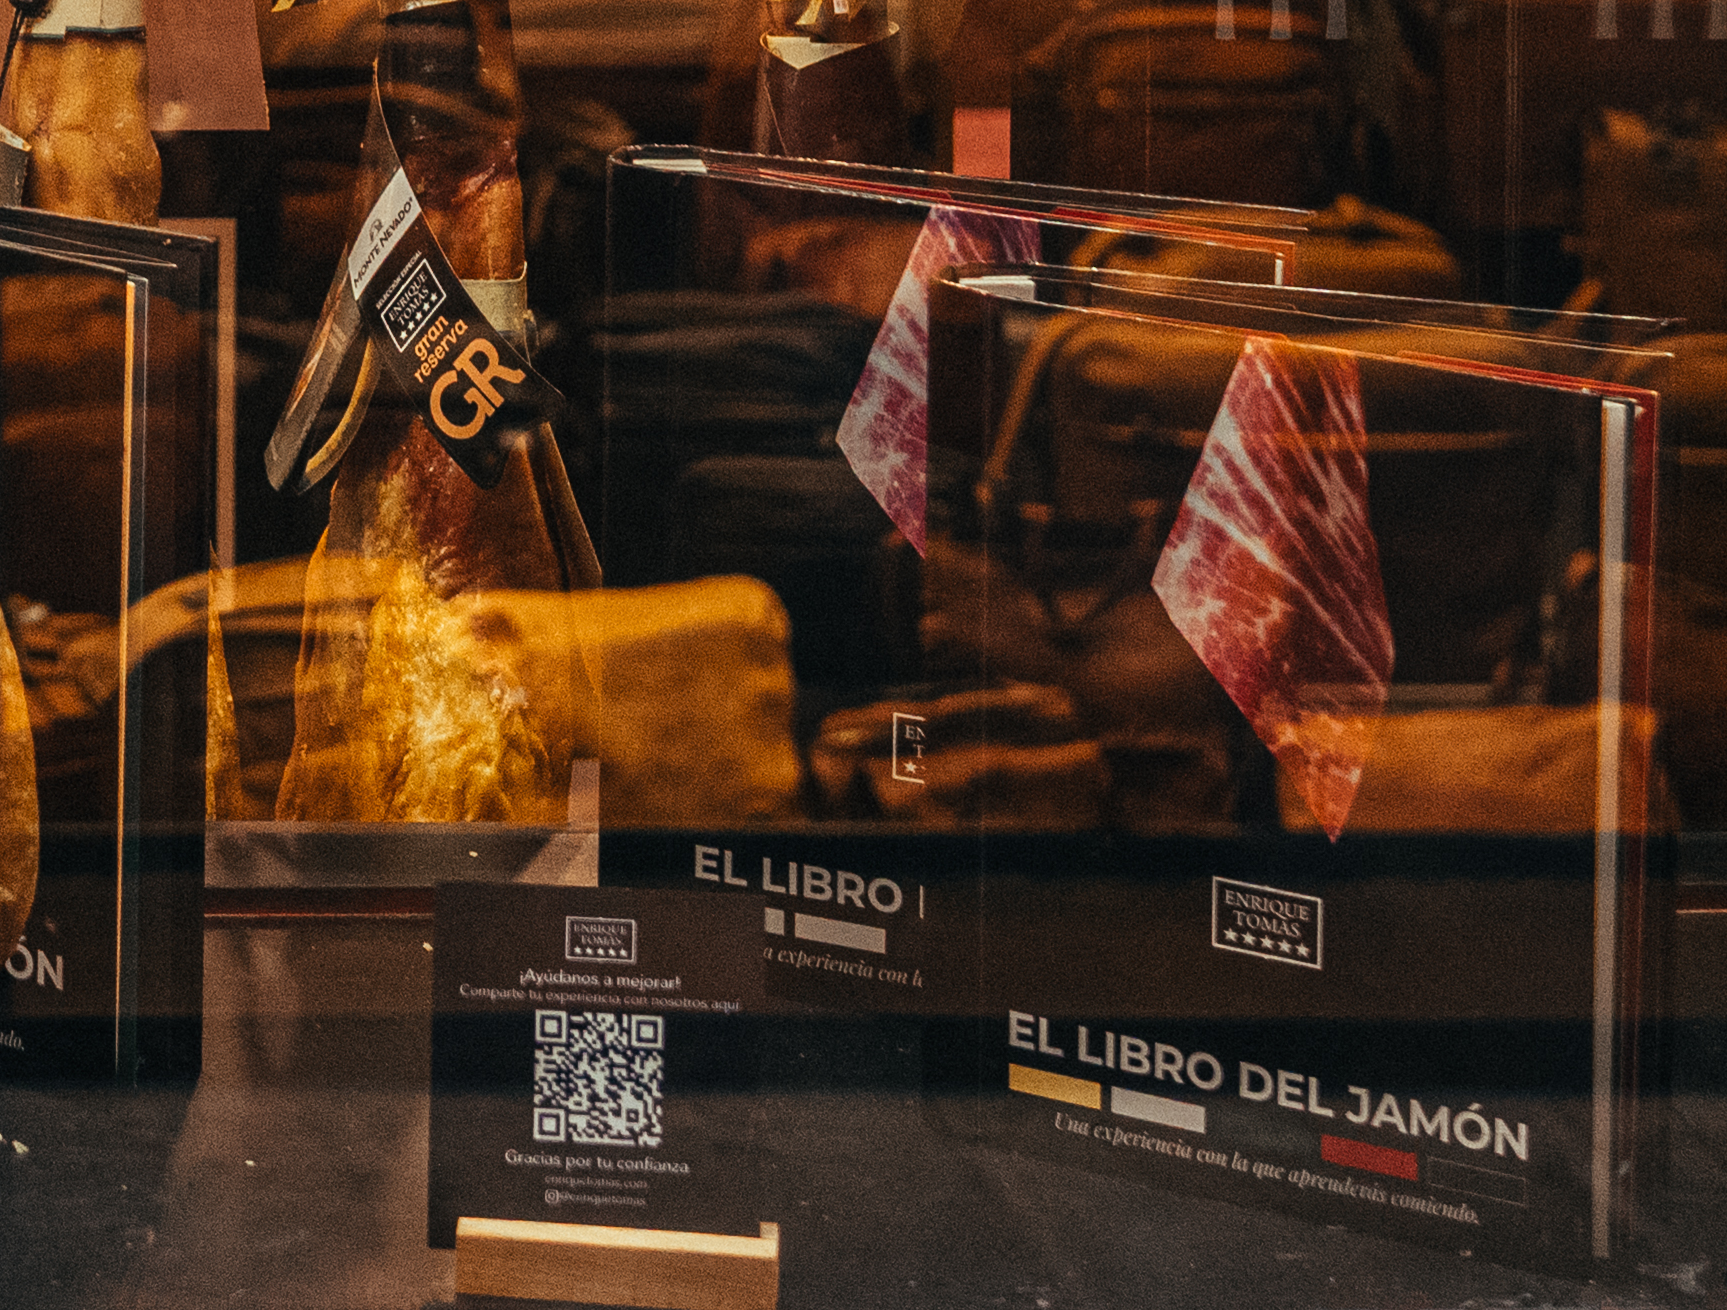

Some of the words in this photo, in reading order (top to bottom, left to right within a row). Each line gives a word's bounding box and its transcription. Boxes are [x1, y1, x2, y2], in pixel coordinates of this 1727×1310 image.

[353, 243, 382, 290] MONTE
[388, 270, 428, 321] ENRIQUE
[413, 318, 469, 383] reserva
[414, 315, 449, 361] gran
[429, 337, 526, 441] GR
[694, 844, 748, 887] EL
[762, 856, 904, 914] LIBRO
[1223, 889, 1311, 921] ENRIQUE
[572, 922, 628, 935] ENRIQUE
[603, 975, 612, 986] a
[616, 974, 682, 991] mejorar!
[777, 948, 874, 980] experiencia
[877, 964, 908, 984] con
[459, 983, 526, 1000] Comparte
[528, 989, 543, 1000] tu
[545, 990, 621, 1005] experiencia
[622, 994, 648, 1006] con
[651, 996, 708, 1010] nosotros
[1008, 1008, 1064, 1058] EL
[1077, 1025, 1225, 1092] LIBRO
[1238, 1060, 1334, 1119] DEL
[1345, 1084, 1531, 1162] JAMÓN
[504, 1148, 560, 1166] Gracias
[565, 1156, 591, 1170] por
[596, 1154, 611, 1168] tu
[616, 1154, 690, 1174] confianza
[1054, 1111, 1089, 1136] Una
[1093, 1122, 1192, 1161] experiencia
[1195, 1144, 1228, 1166] con
[1230, 1149, 1248, 1172] la
[1251, 1158, 1286, 1184] que
[1288, 1165, 1386, 1207] aprenderás
